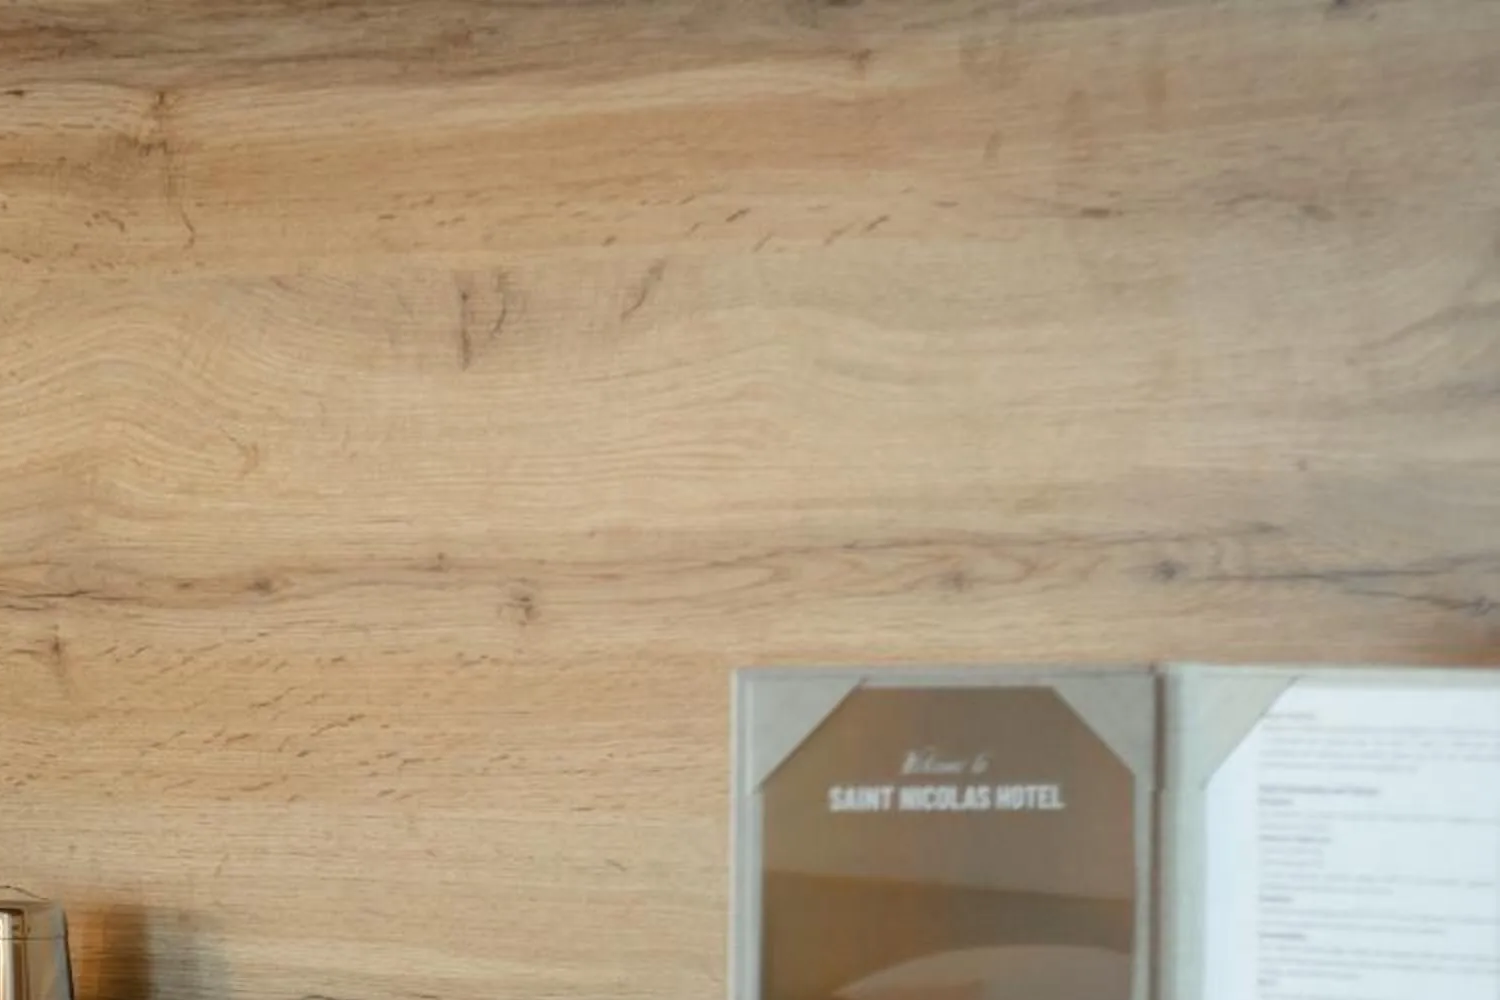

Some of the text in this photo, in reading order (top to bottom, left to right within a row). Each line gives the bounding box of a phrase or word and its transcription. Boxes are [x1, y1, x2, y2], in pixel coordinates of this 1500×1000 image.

[828, 784, 1066, 812] SAINT NICOLAS HOTEL
